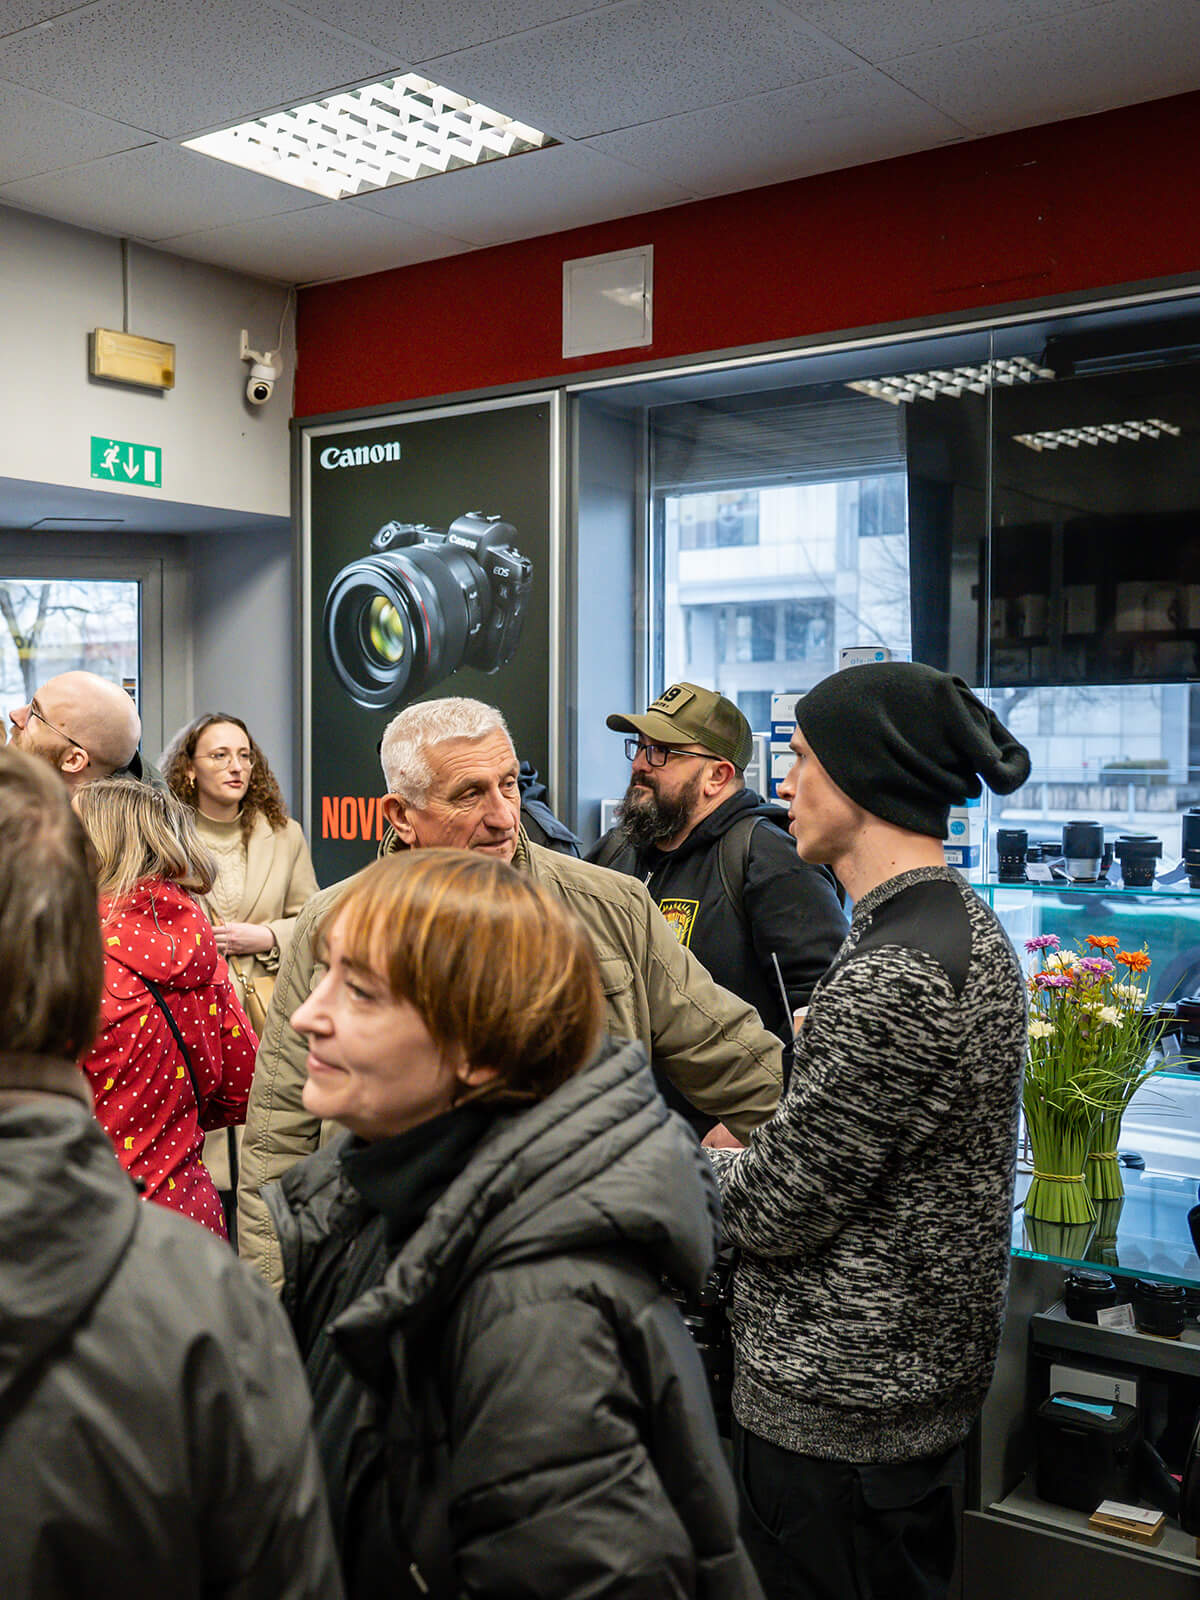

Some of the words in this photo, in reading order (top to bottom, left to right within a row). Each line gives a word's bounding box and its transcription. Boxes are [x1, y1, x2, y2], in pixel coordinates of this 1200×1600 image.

[320, 441, 401, 470] Canon
[449, 534, 478, 550] Canon
[493, 566, 510, 577] EOS
